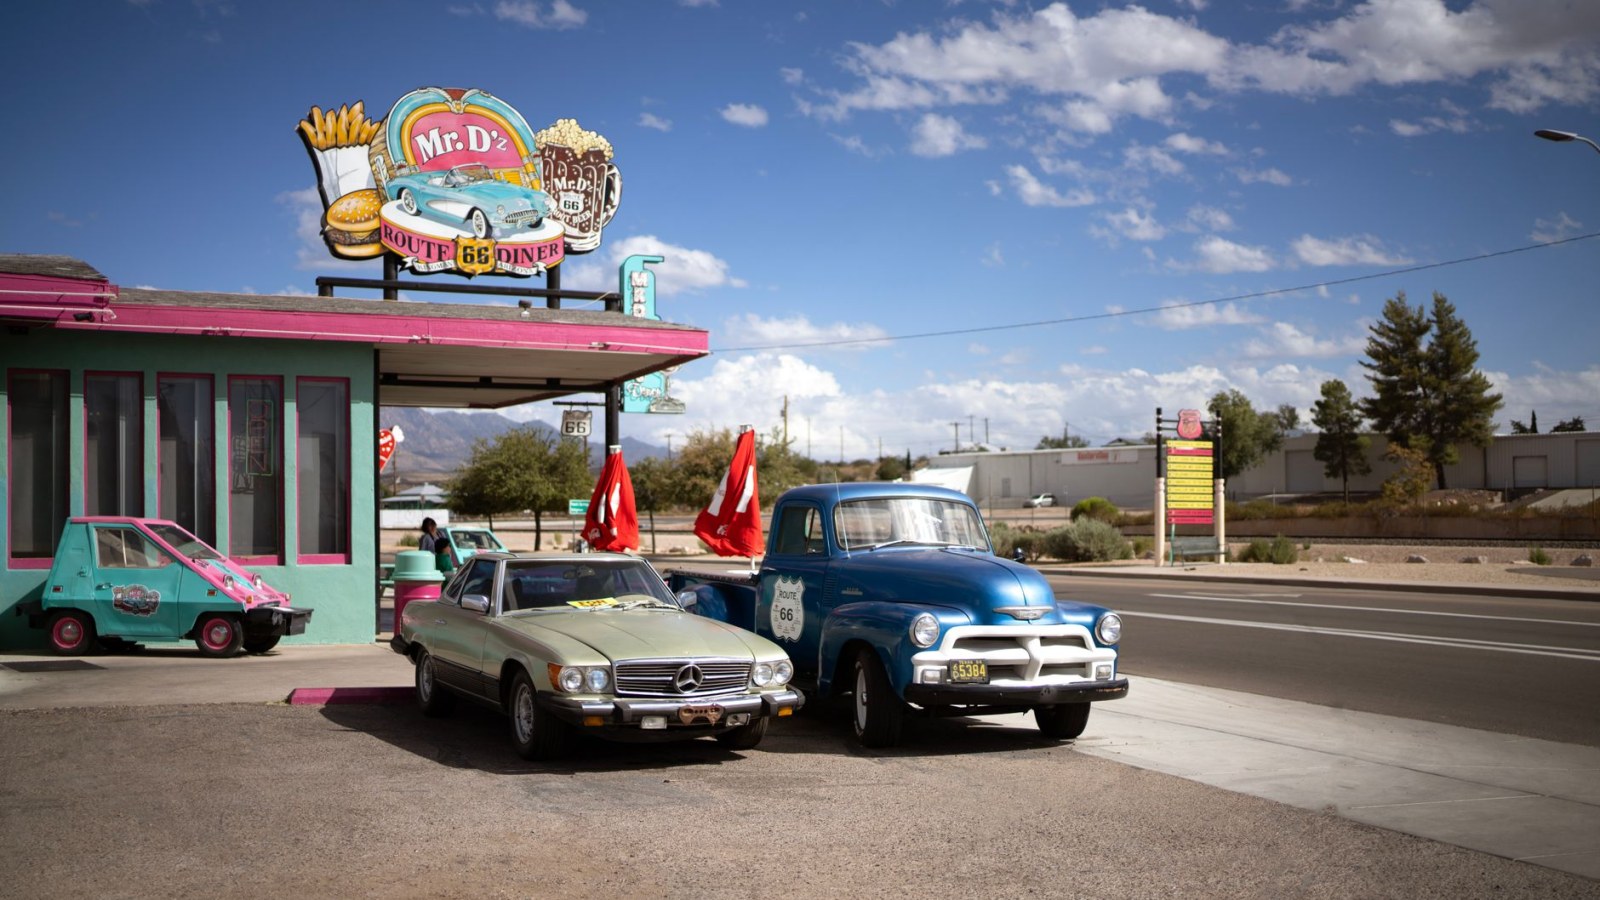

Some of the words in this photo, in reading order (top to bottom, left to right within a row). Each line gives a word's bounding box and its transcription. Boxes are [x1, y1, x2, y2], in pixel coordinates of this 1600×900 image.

[413, 126, 464, 165] Mr.
[463, 124, 508, 152] D'z
[563, 200, 580, 211] 66
[383, 223, 450, 262] ROUTE
[461, 245, 490, 265] 66
[496, 242, 560, 264] DINER
[565, 421, 587, 434] 66
[778, 590, 798, 600] ROUTE
[780, 607, 794, 621] 66
[959, 664, 987, 678] 5384
